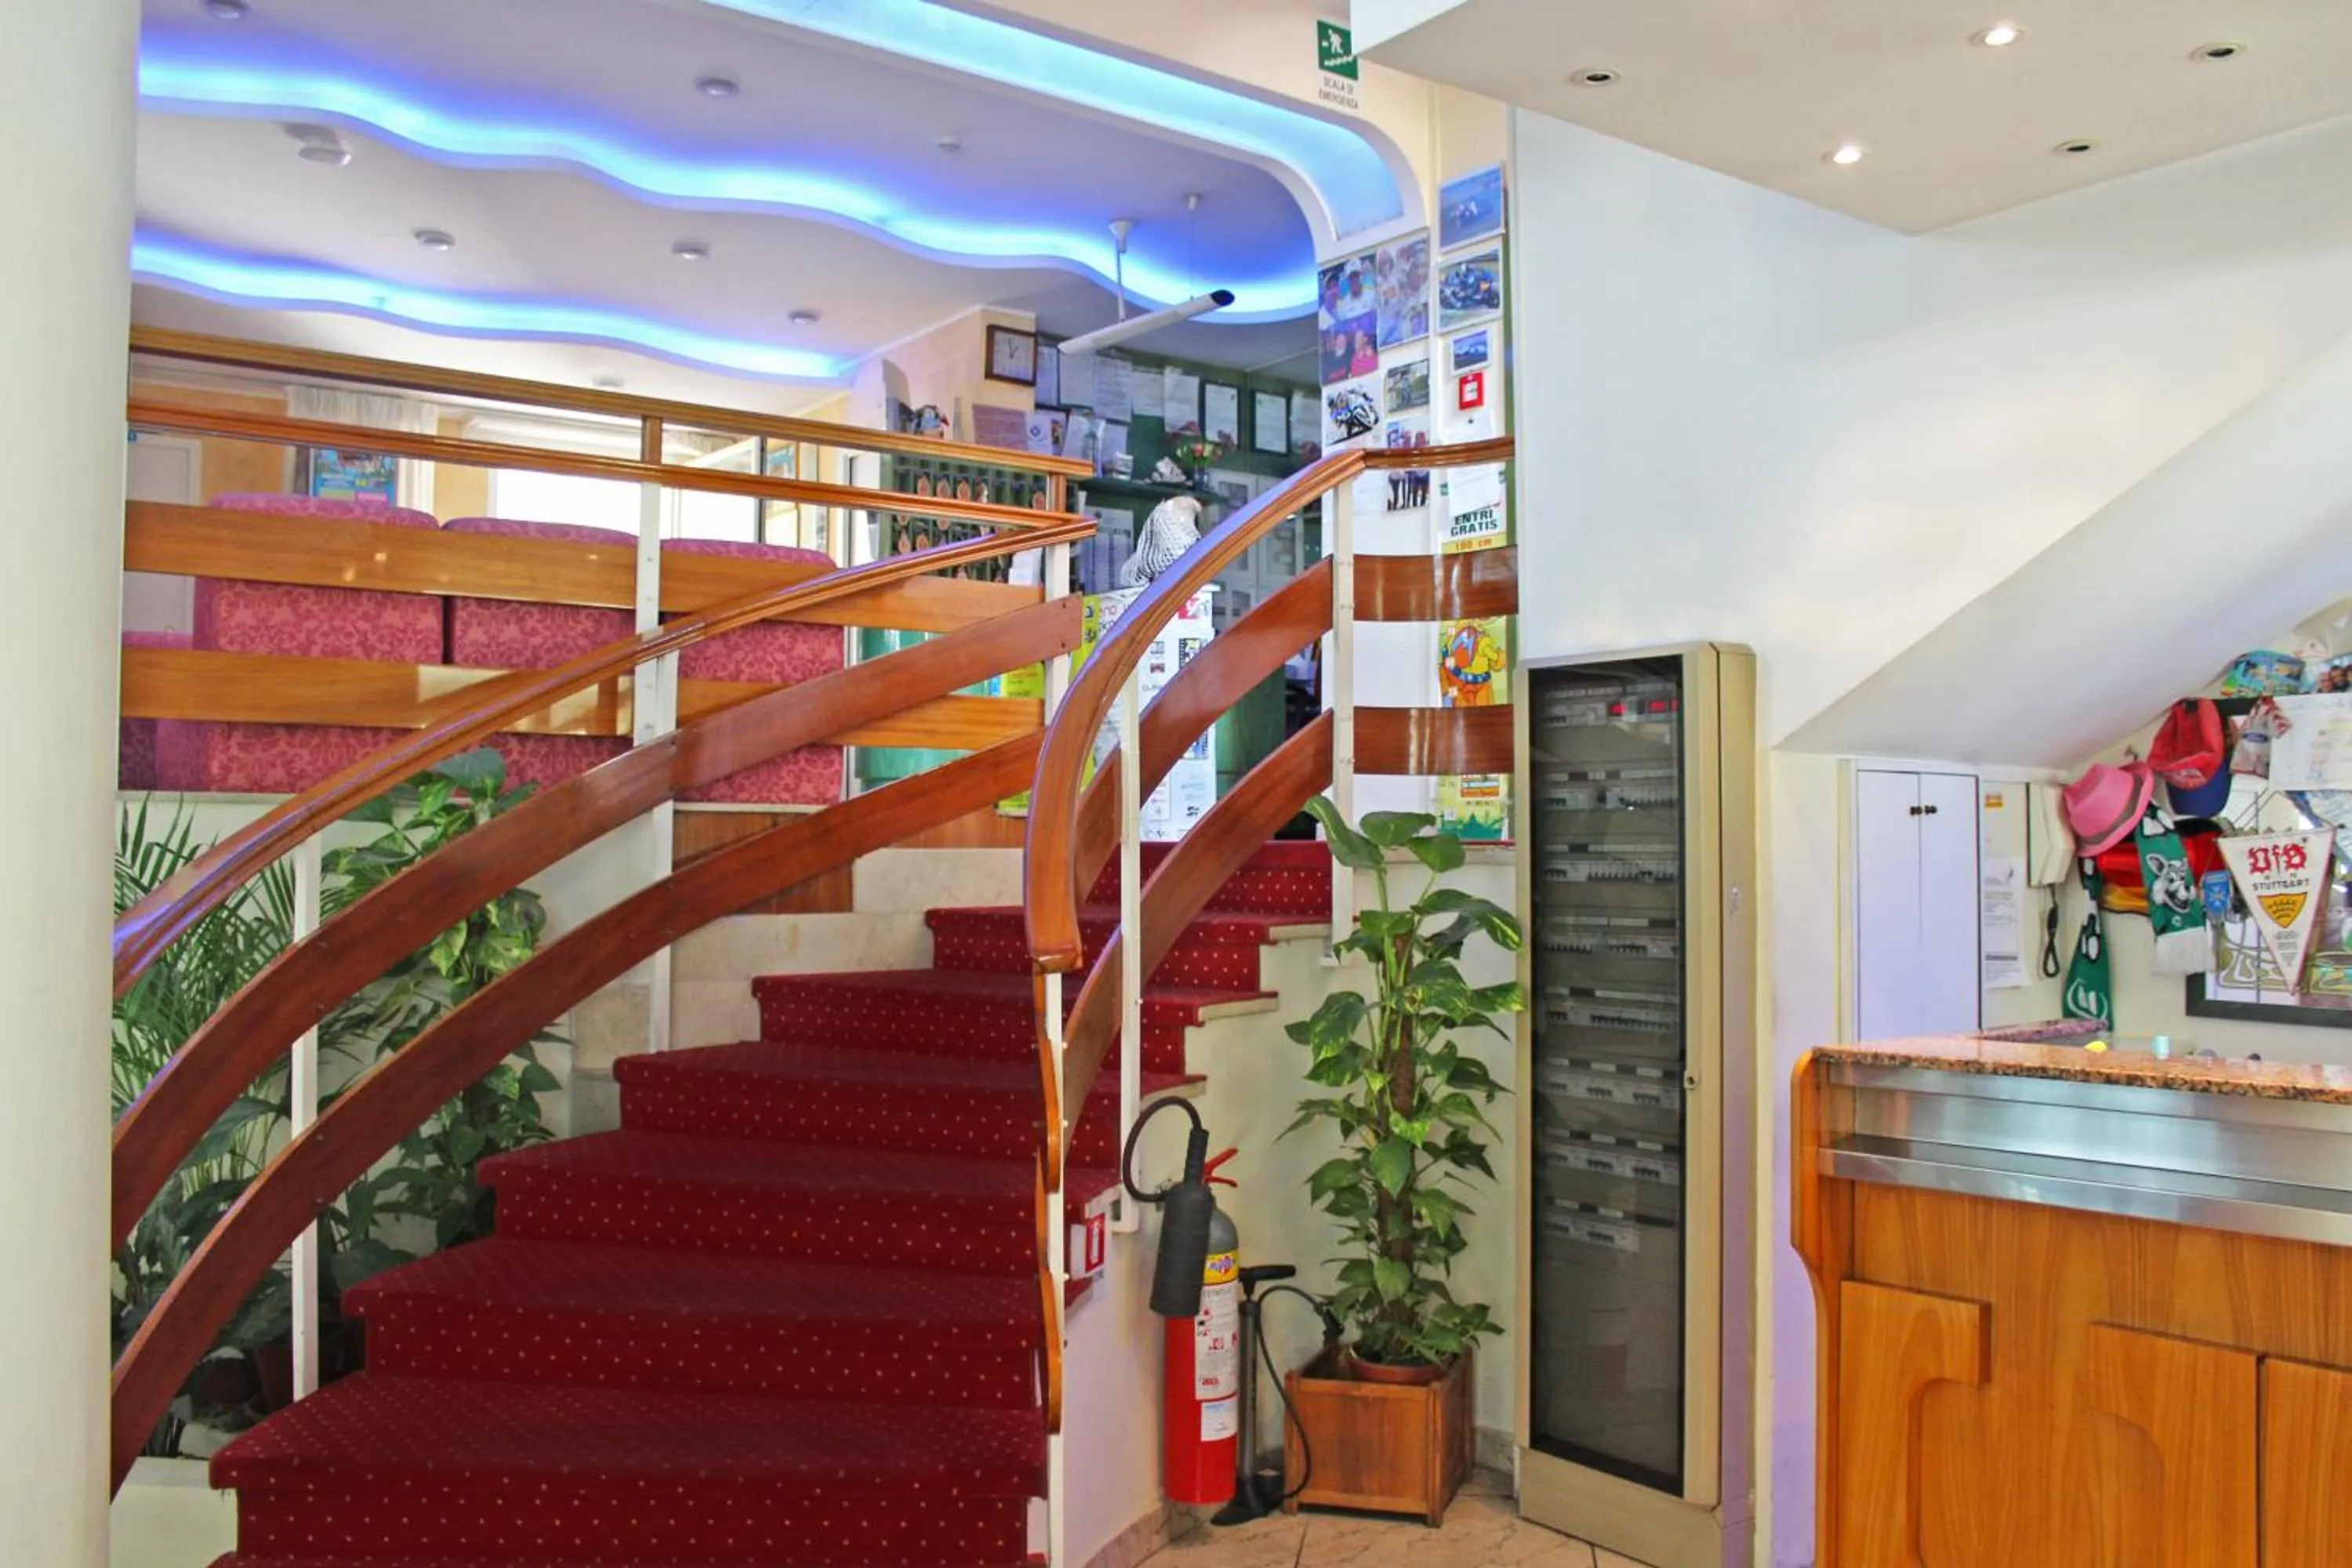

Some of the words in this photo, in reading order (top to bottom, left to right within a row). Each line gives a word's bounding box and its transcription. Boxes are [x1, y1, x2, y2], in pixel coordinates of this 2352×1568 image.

[1323, 76, 1345, 92] SCALA
[1318, 87, 1359, 110] EMERGENZA
[1454, 508, 1494, 526] ENTRI
[1450, 518, 1498, 537] GRATIS
[2252, 878, 2310, 892] STUTTGART
